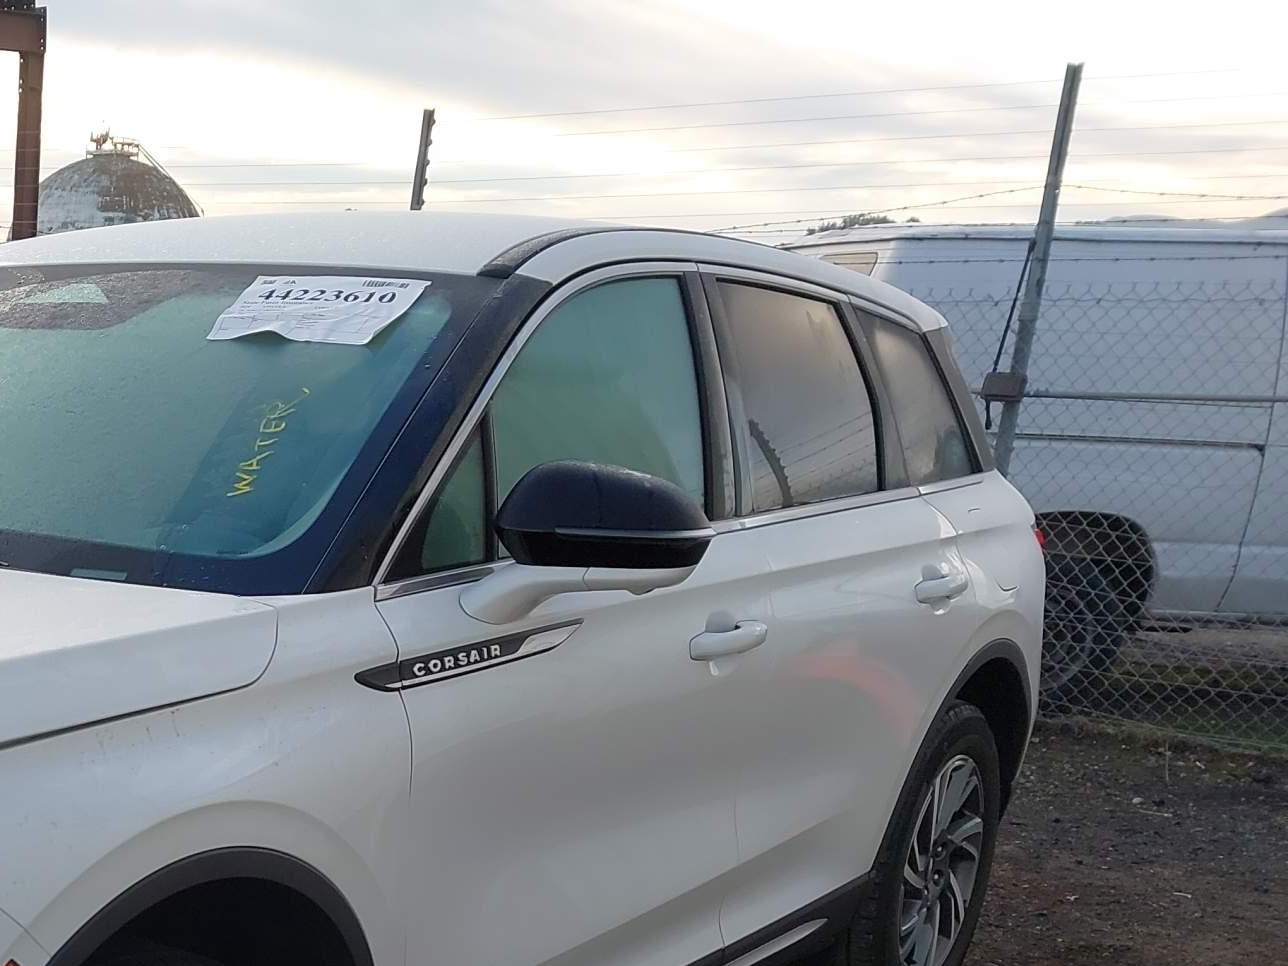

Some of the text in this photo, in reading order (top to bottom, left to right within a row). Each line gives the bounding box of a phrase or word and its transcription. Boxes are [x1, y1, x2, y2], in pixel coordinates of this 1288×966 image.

[258, 288, 397, 304] 44223610
[227, 388, 309, 496] WATER
[413, 643, 502, 676] CORSAIR
